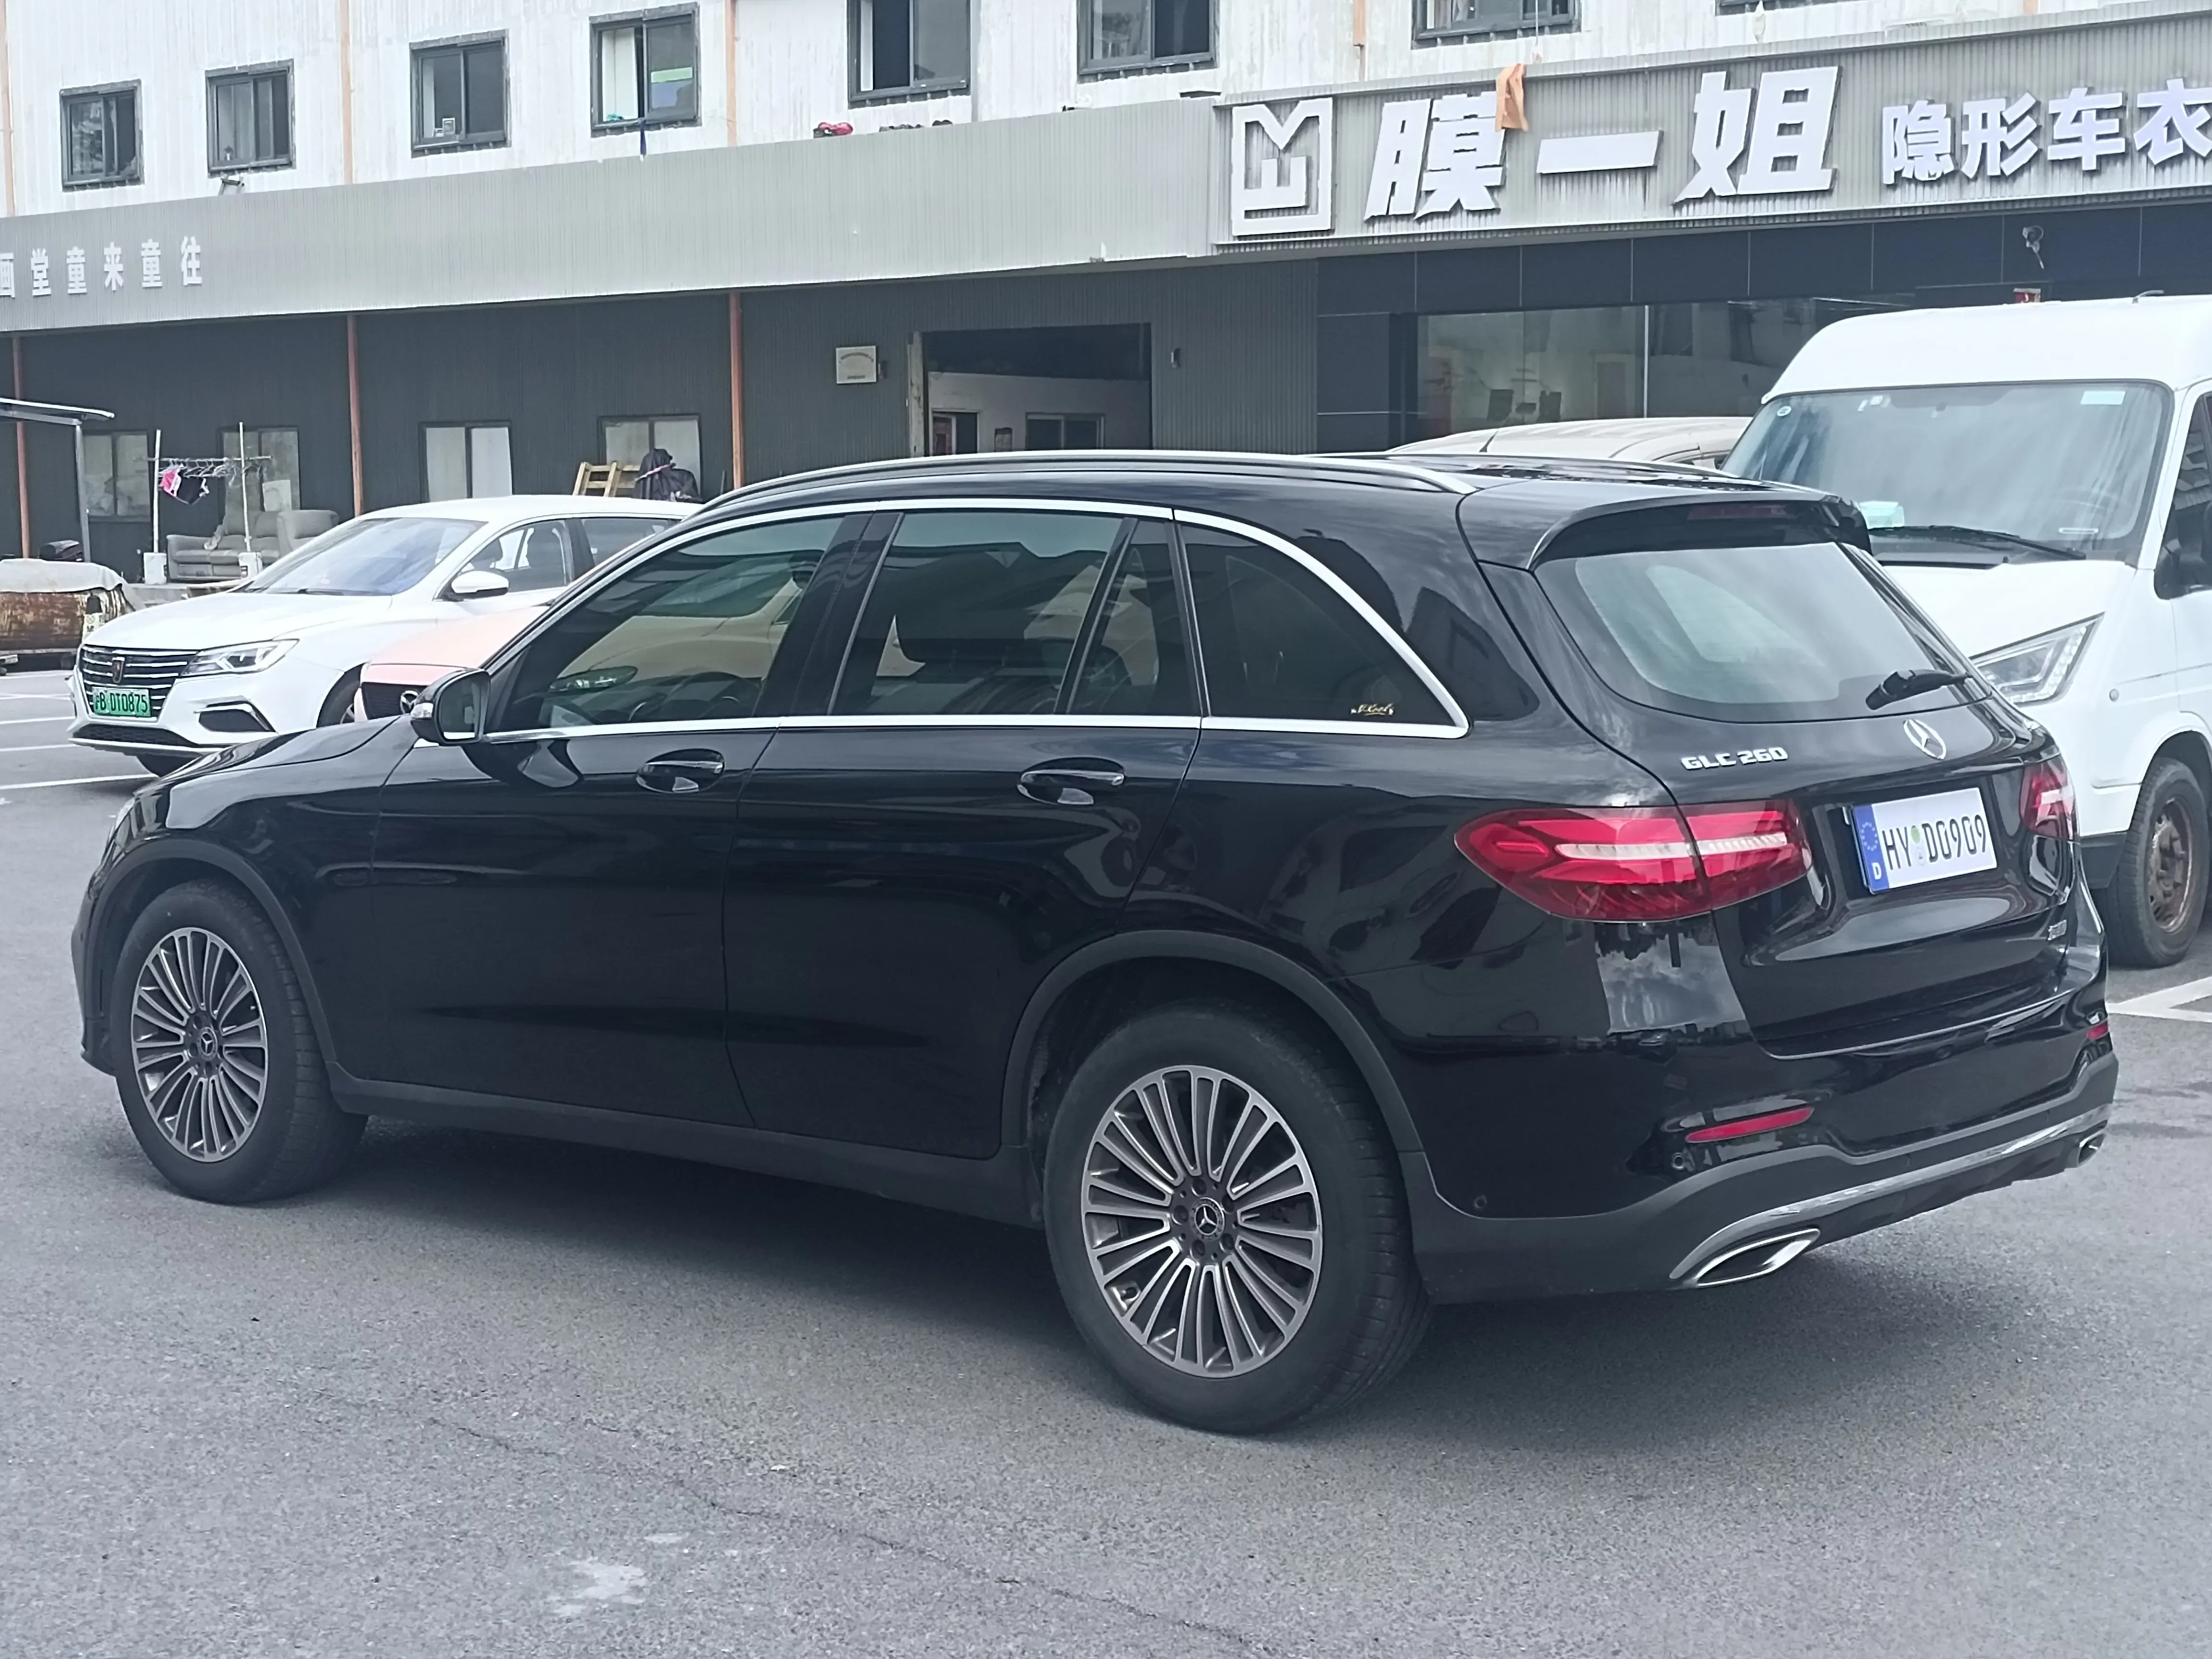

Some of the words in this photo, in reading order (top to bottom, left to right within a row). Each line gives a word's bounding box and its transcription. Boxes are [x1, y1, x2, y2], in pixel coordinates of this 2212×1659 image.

[1364, 66, 1839, 221] 膜一姐
[1883, 78, 2212, 184] 隐形车衣
[1681, 752, 1736, 770] GLC
[1737, 747, 1788, 765] 260
[1882, 826, 1912, 870] HY
[1872, 862, 1882, 880] D
